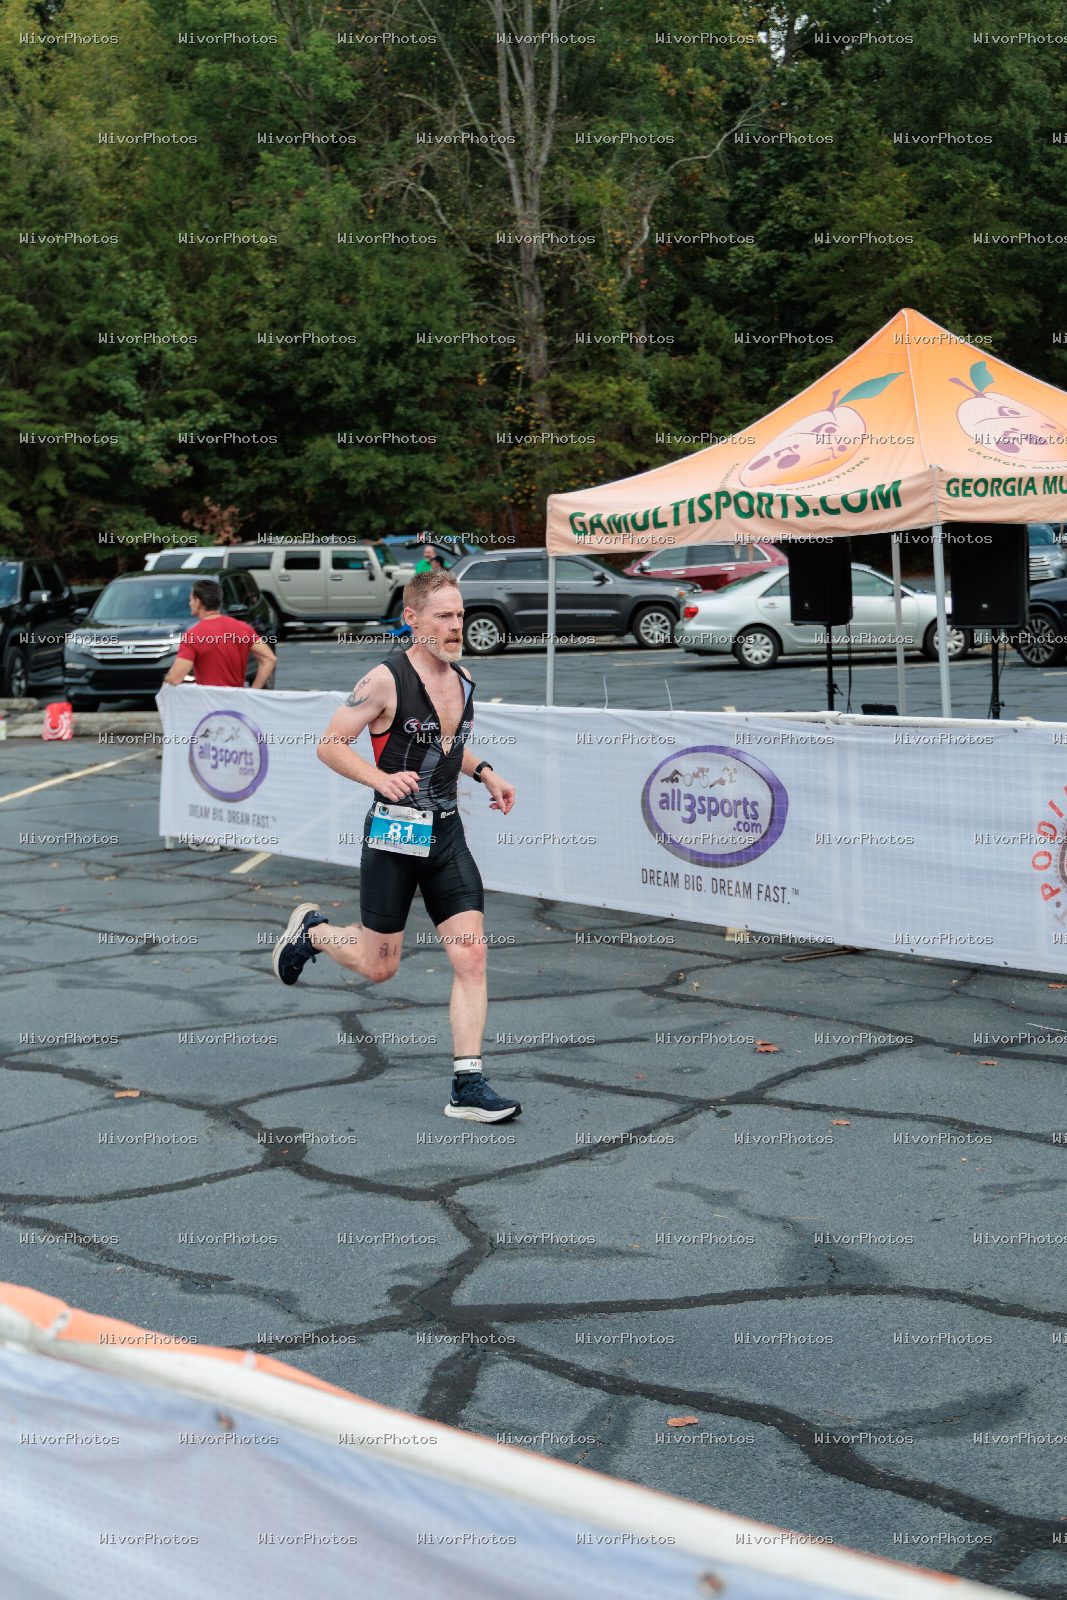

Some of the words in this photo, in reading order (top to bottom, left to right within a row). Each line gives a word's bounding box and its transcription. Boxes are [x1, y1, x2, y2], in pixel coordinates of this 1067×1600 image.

[781, 456, 870, 492] RODUCTIONS
[946, 476, 1036, 498] GEORGIA
[569, 480, 902, 535] GAMULTISPORTS.COM
[199, 742, 254, 769] all3sports
[189, 804, 210, 819] DREAM
[227, 809, 250, 825] DREAM
[658, 788, 760, 824] all3sports
[388, 822, 414, 843] 81
[732, 820, 762, 834] .com
[641, 868, 680, 889] DREAM
[684, 873, 707, 893] BIG.
[711, 877, 752, 900] DREAM
